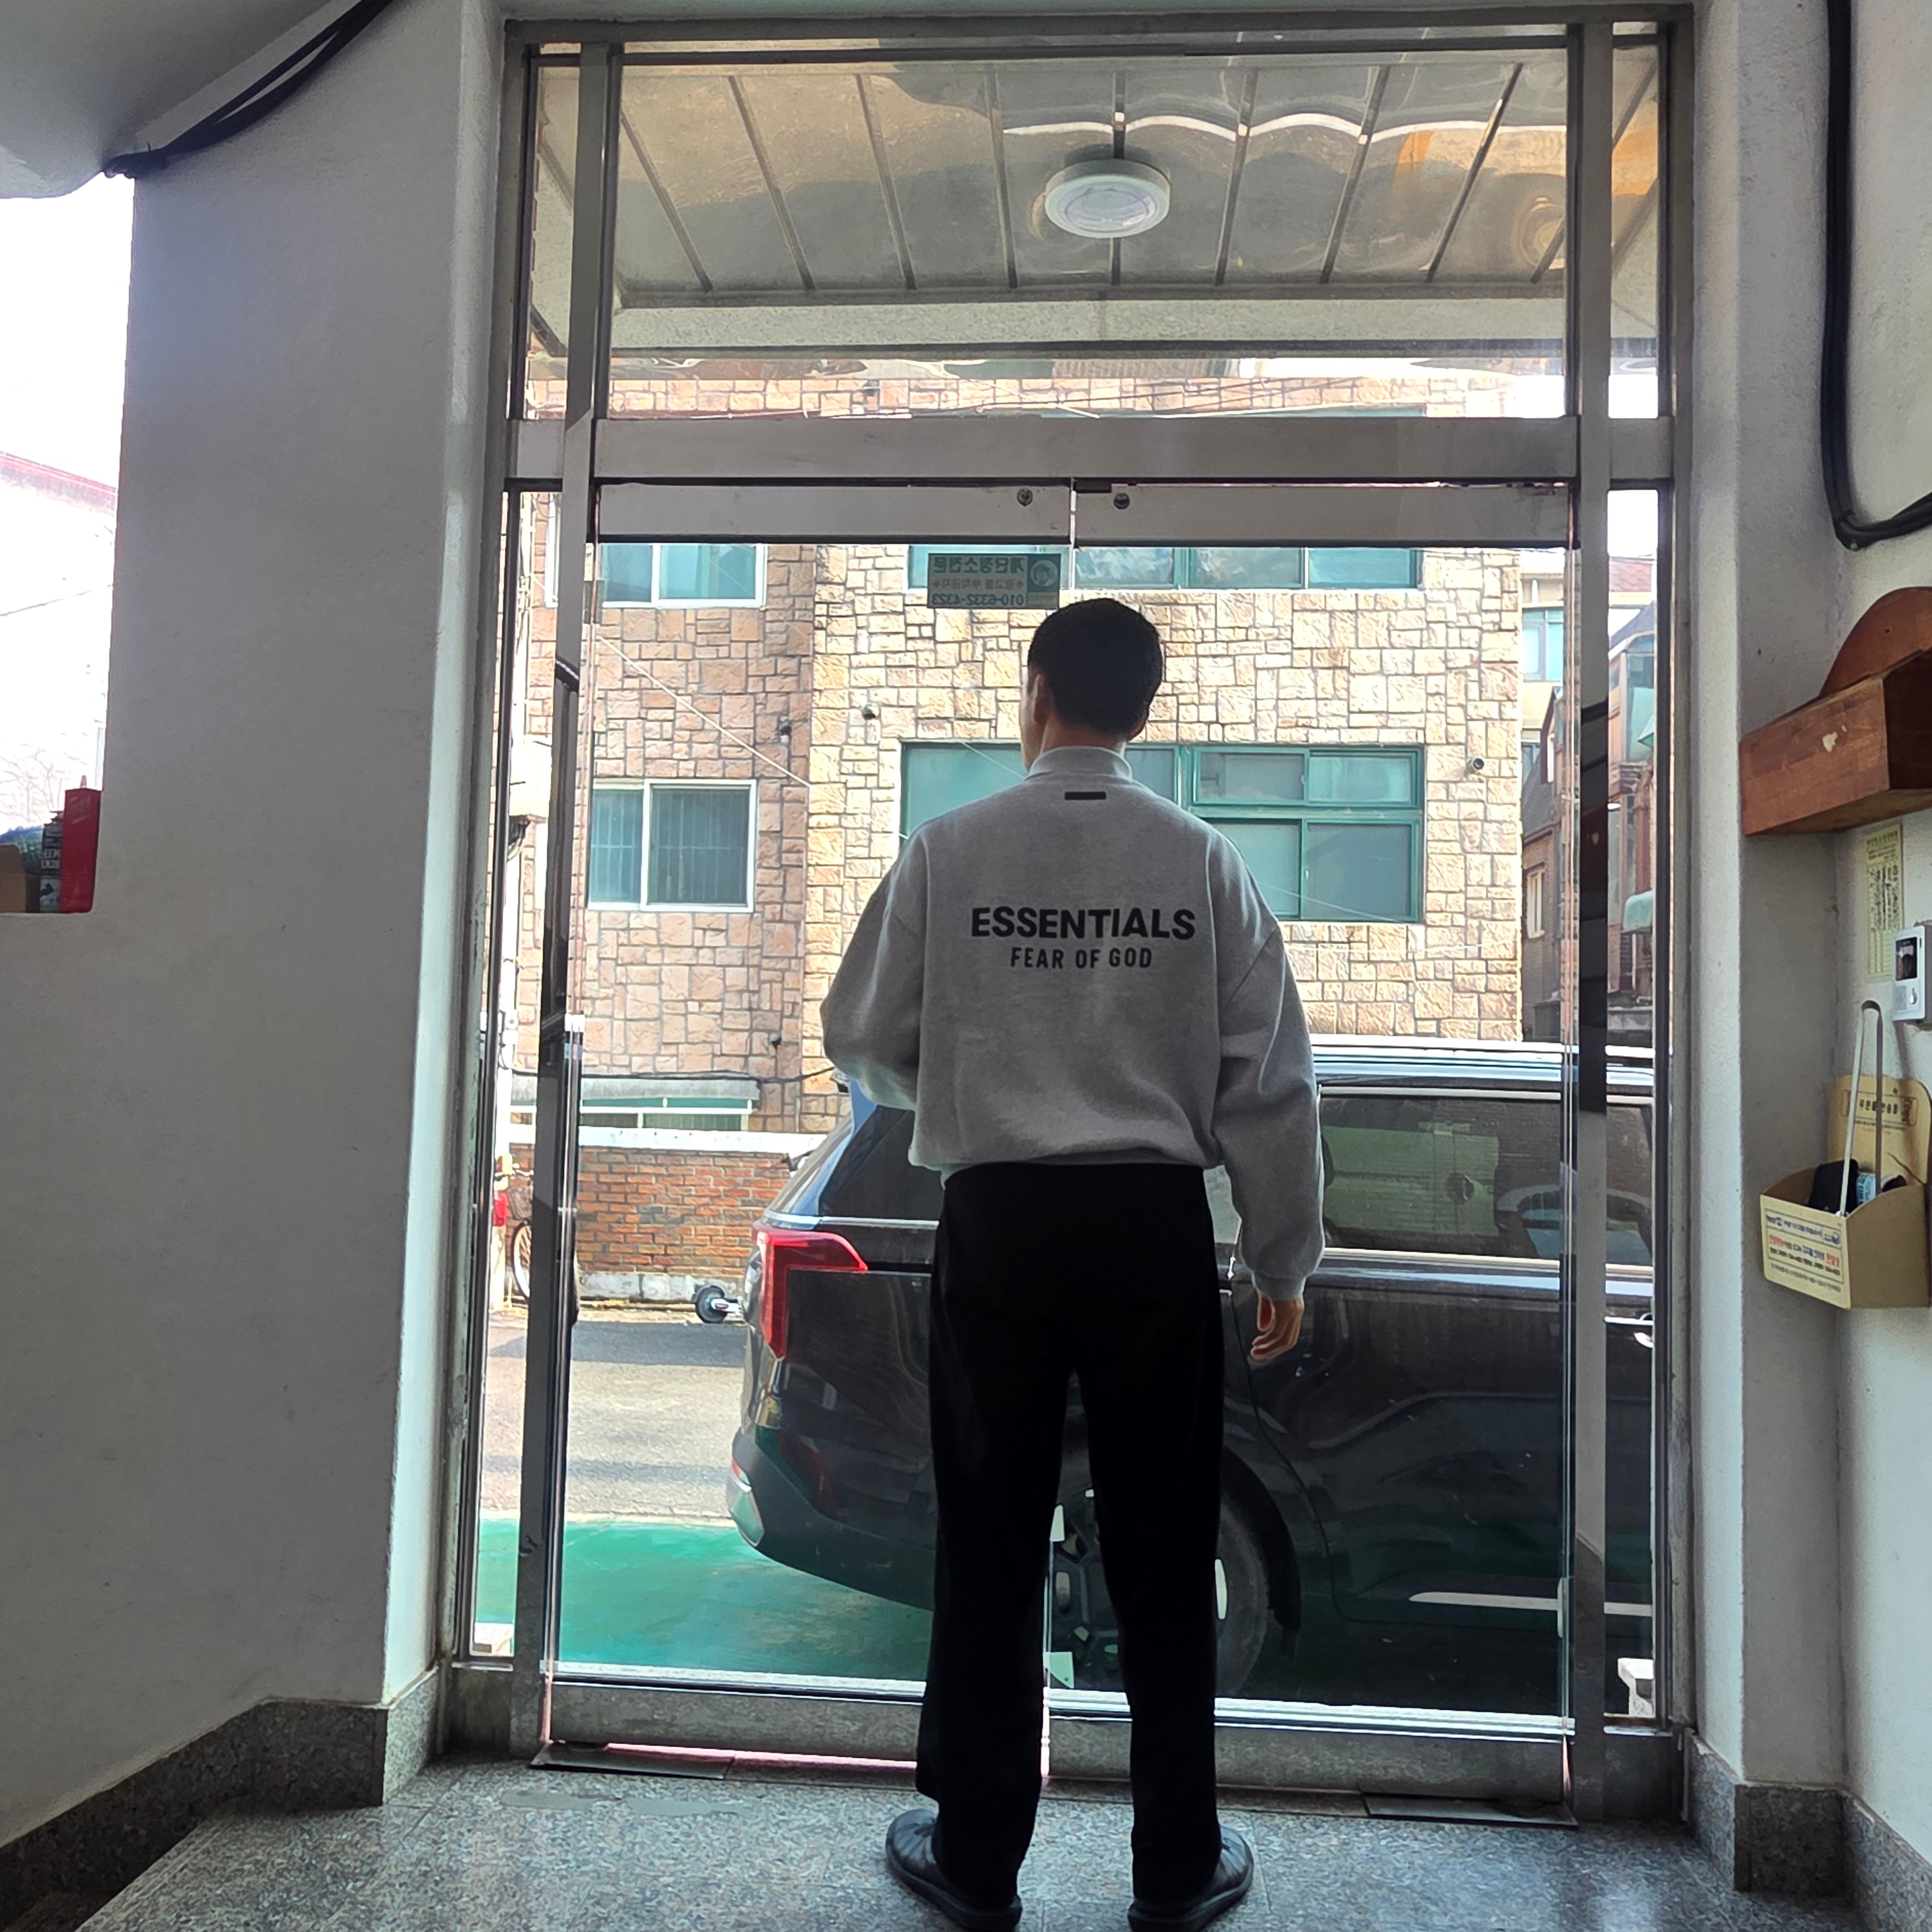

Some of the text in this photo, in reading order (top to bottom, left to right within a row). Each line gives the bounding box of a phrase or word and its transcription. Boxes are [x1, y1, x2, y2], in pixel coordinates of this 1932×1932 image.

[971, 906, 1195, 940] ESSENTIALS
[1010, 947, 1152, 969] FEAR OF GOD
